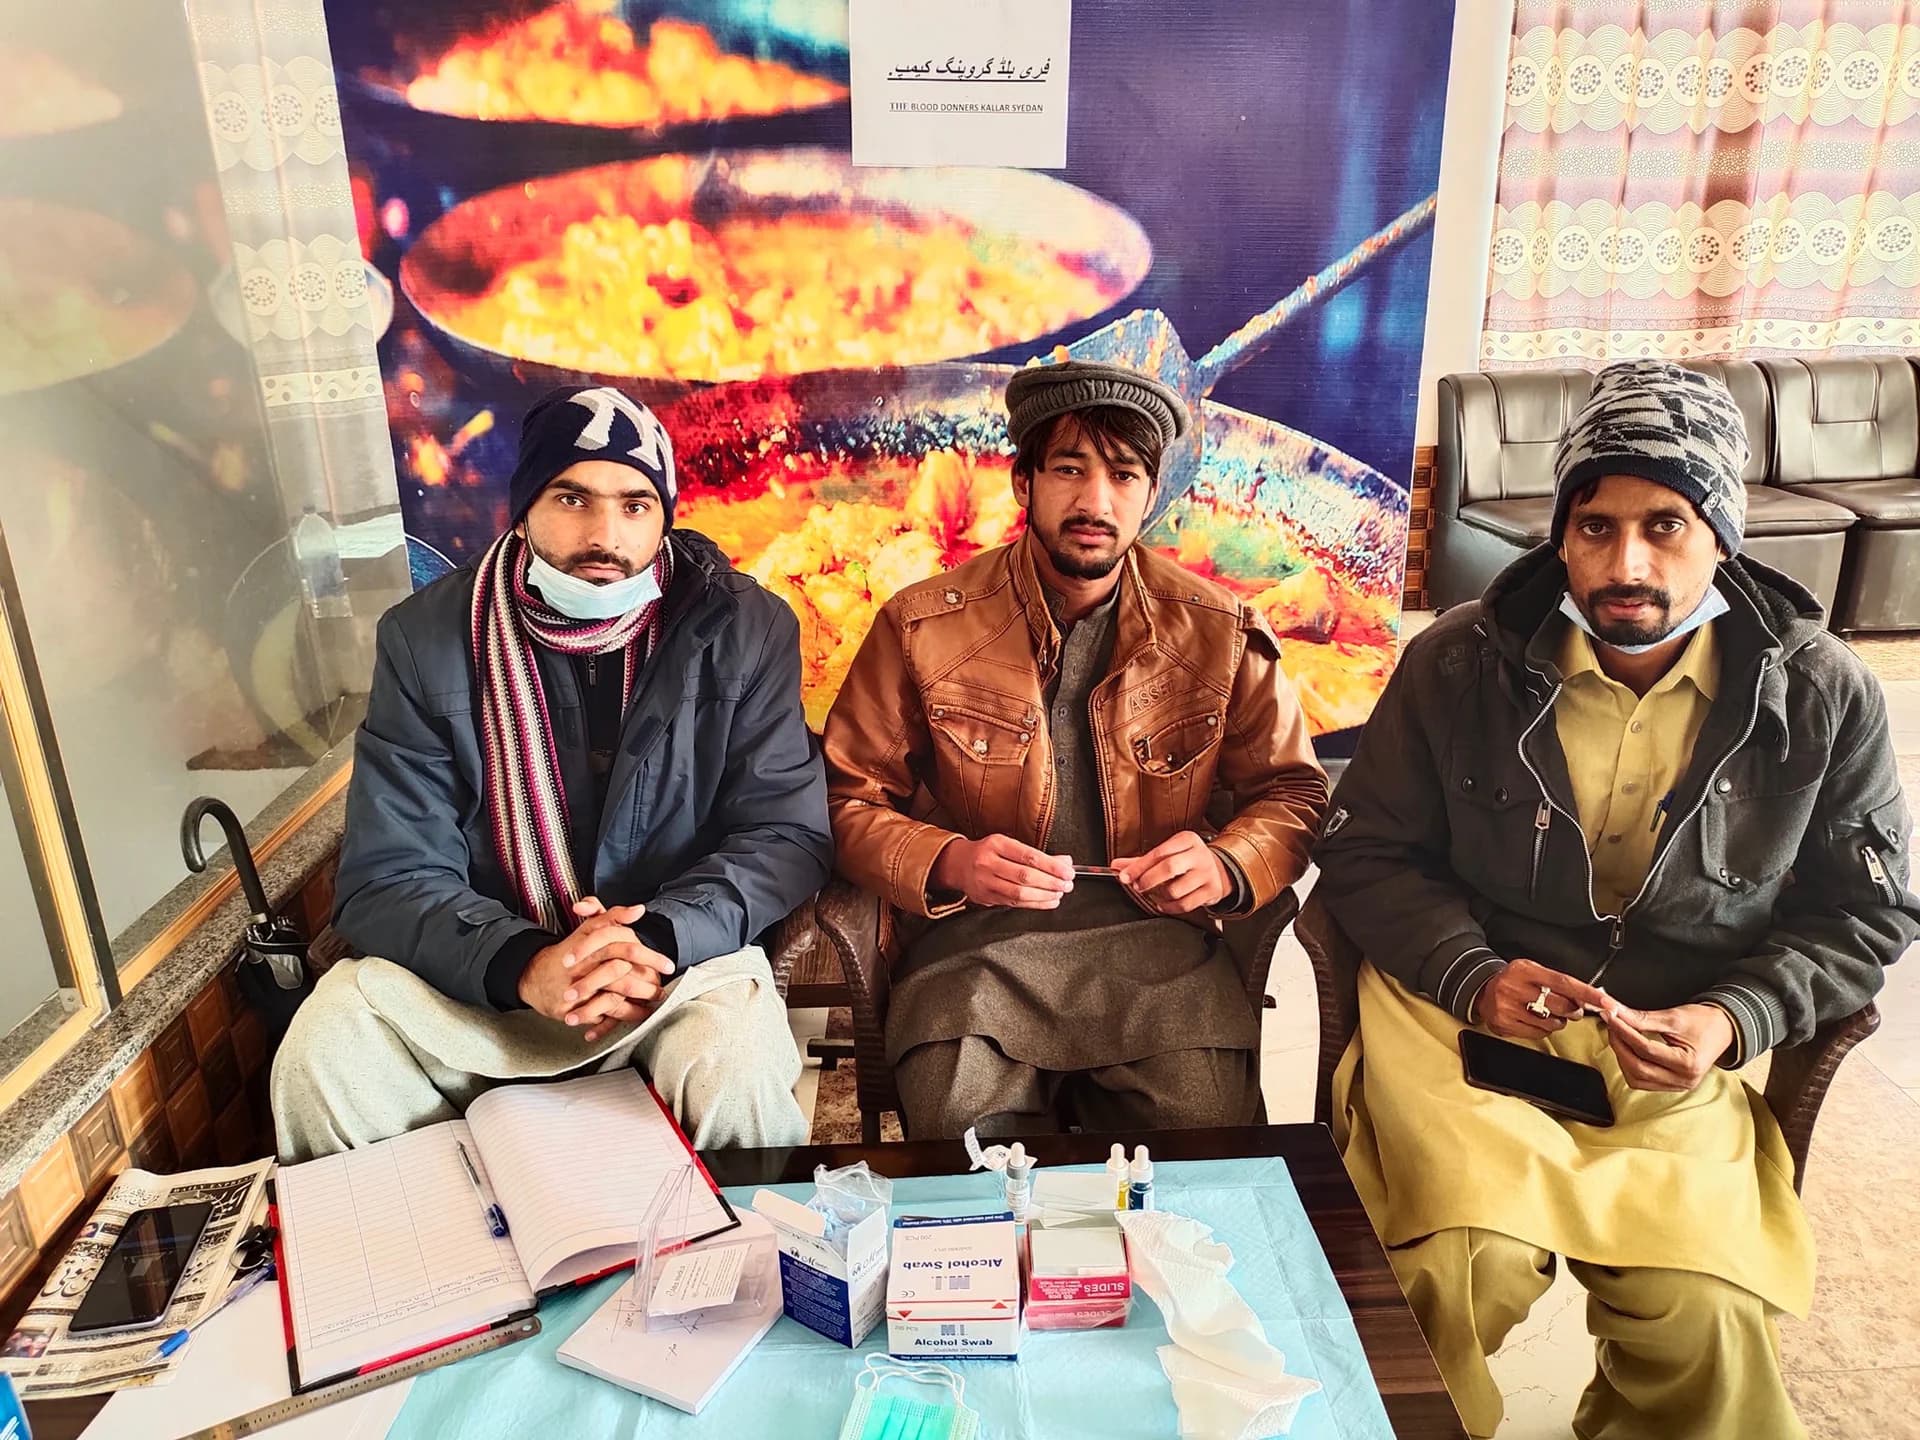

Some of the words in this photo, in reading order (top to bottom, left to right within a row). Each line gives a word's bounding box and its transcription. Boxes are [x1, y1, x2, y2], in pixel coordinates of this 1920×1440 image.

[997, 56, 1016, 79] بلڈ
[1019, 58, 1051, 79] فری
[911, 103, 938, 111] BLOOD
[940, 103, 978, 112] DONNERS
[981, 104, 1009, 112] KALLAR
[1012, 104, 1044, 112] SYEDAN
[903, 1260, 943, 1270] Swab
[948, 1258, 1003, 1270] Alcohol
[1083, 1282, 1126, 1293] SLIDES
[914, 1338, 958, 1346] Alcohol
[961, 1338, 993, 1346] Swab
